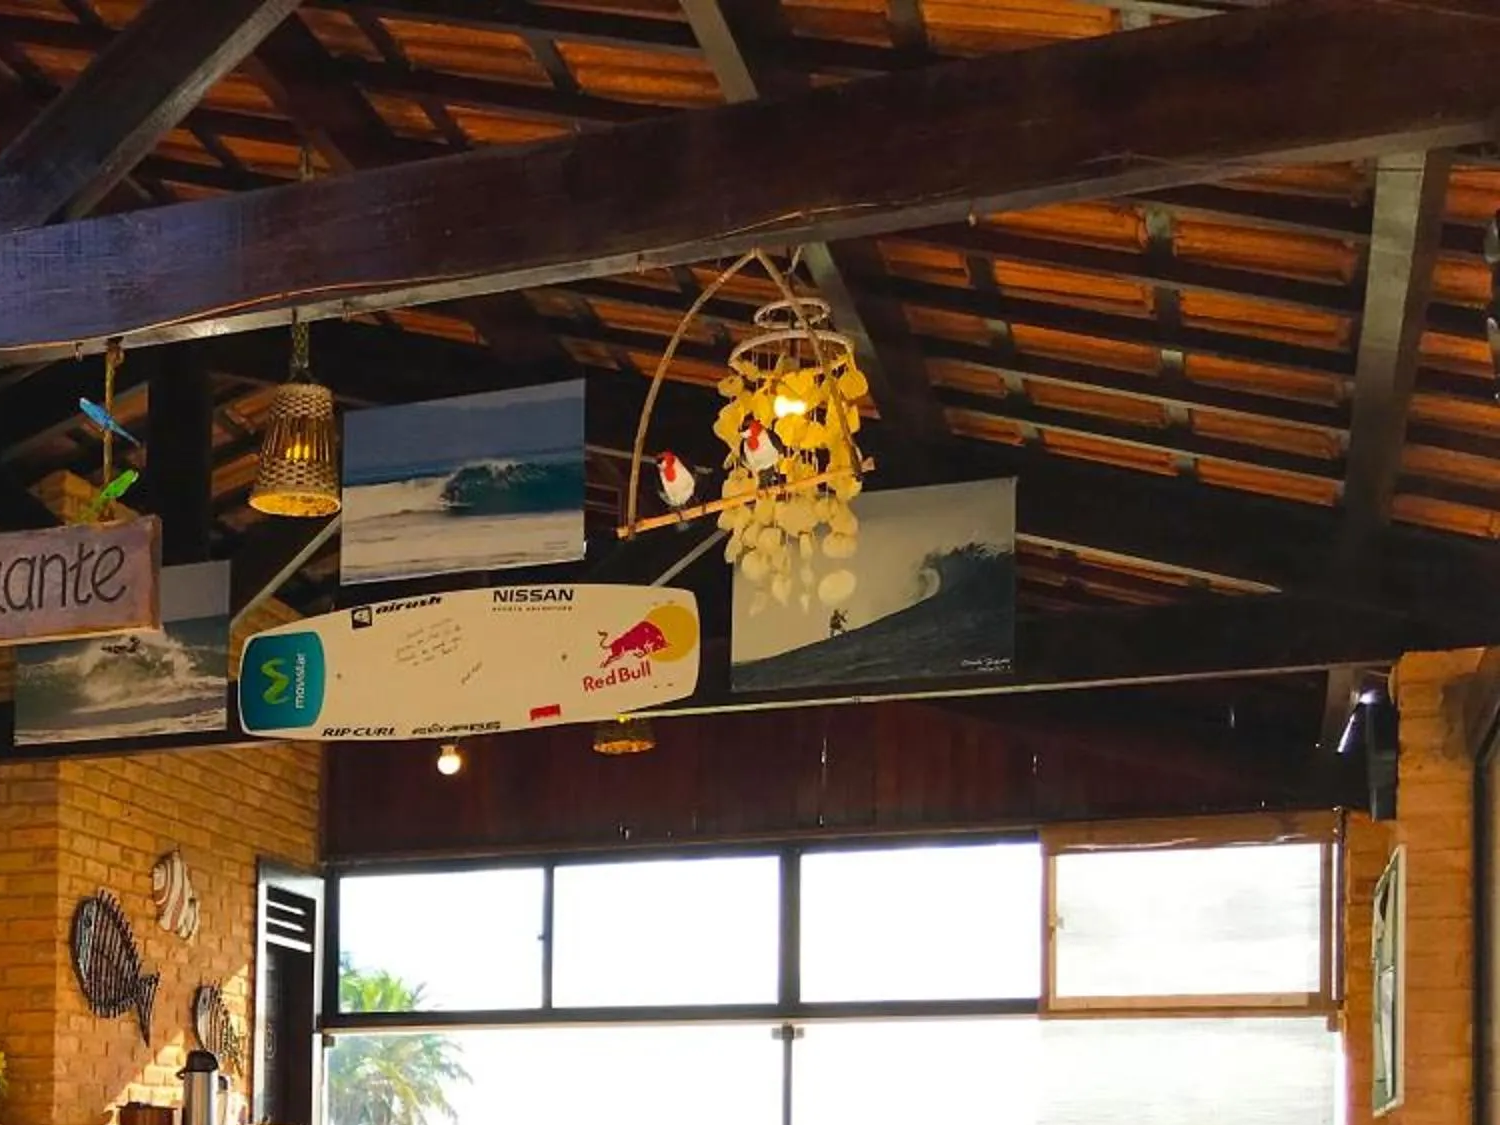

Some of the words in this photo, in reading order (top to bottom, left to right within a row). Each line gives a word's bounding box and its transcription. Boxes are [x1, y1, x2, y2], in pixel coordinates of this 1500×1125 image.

[493, 588, 574, 602] NISSAN
[582, 669, 617, 692] Red
[618, 659, 651, 683] Bull
[322, 727, 351, 737] RIP
[352, 727, 397, 737] CURL
